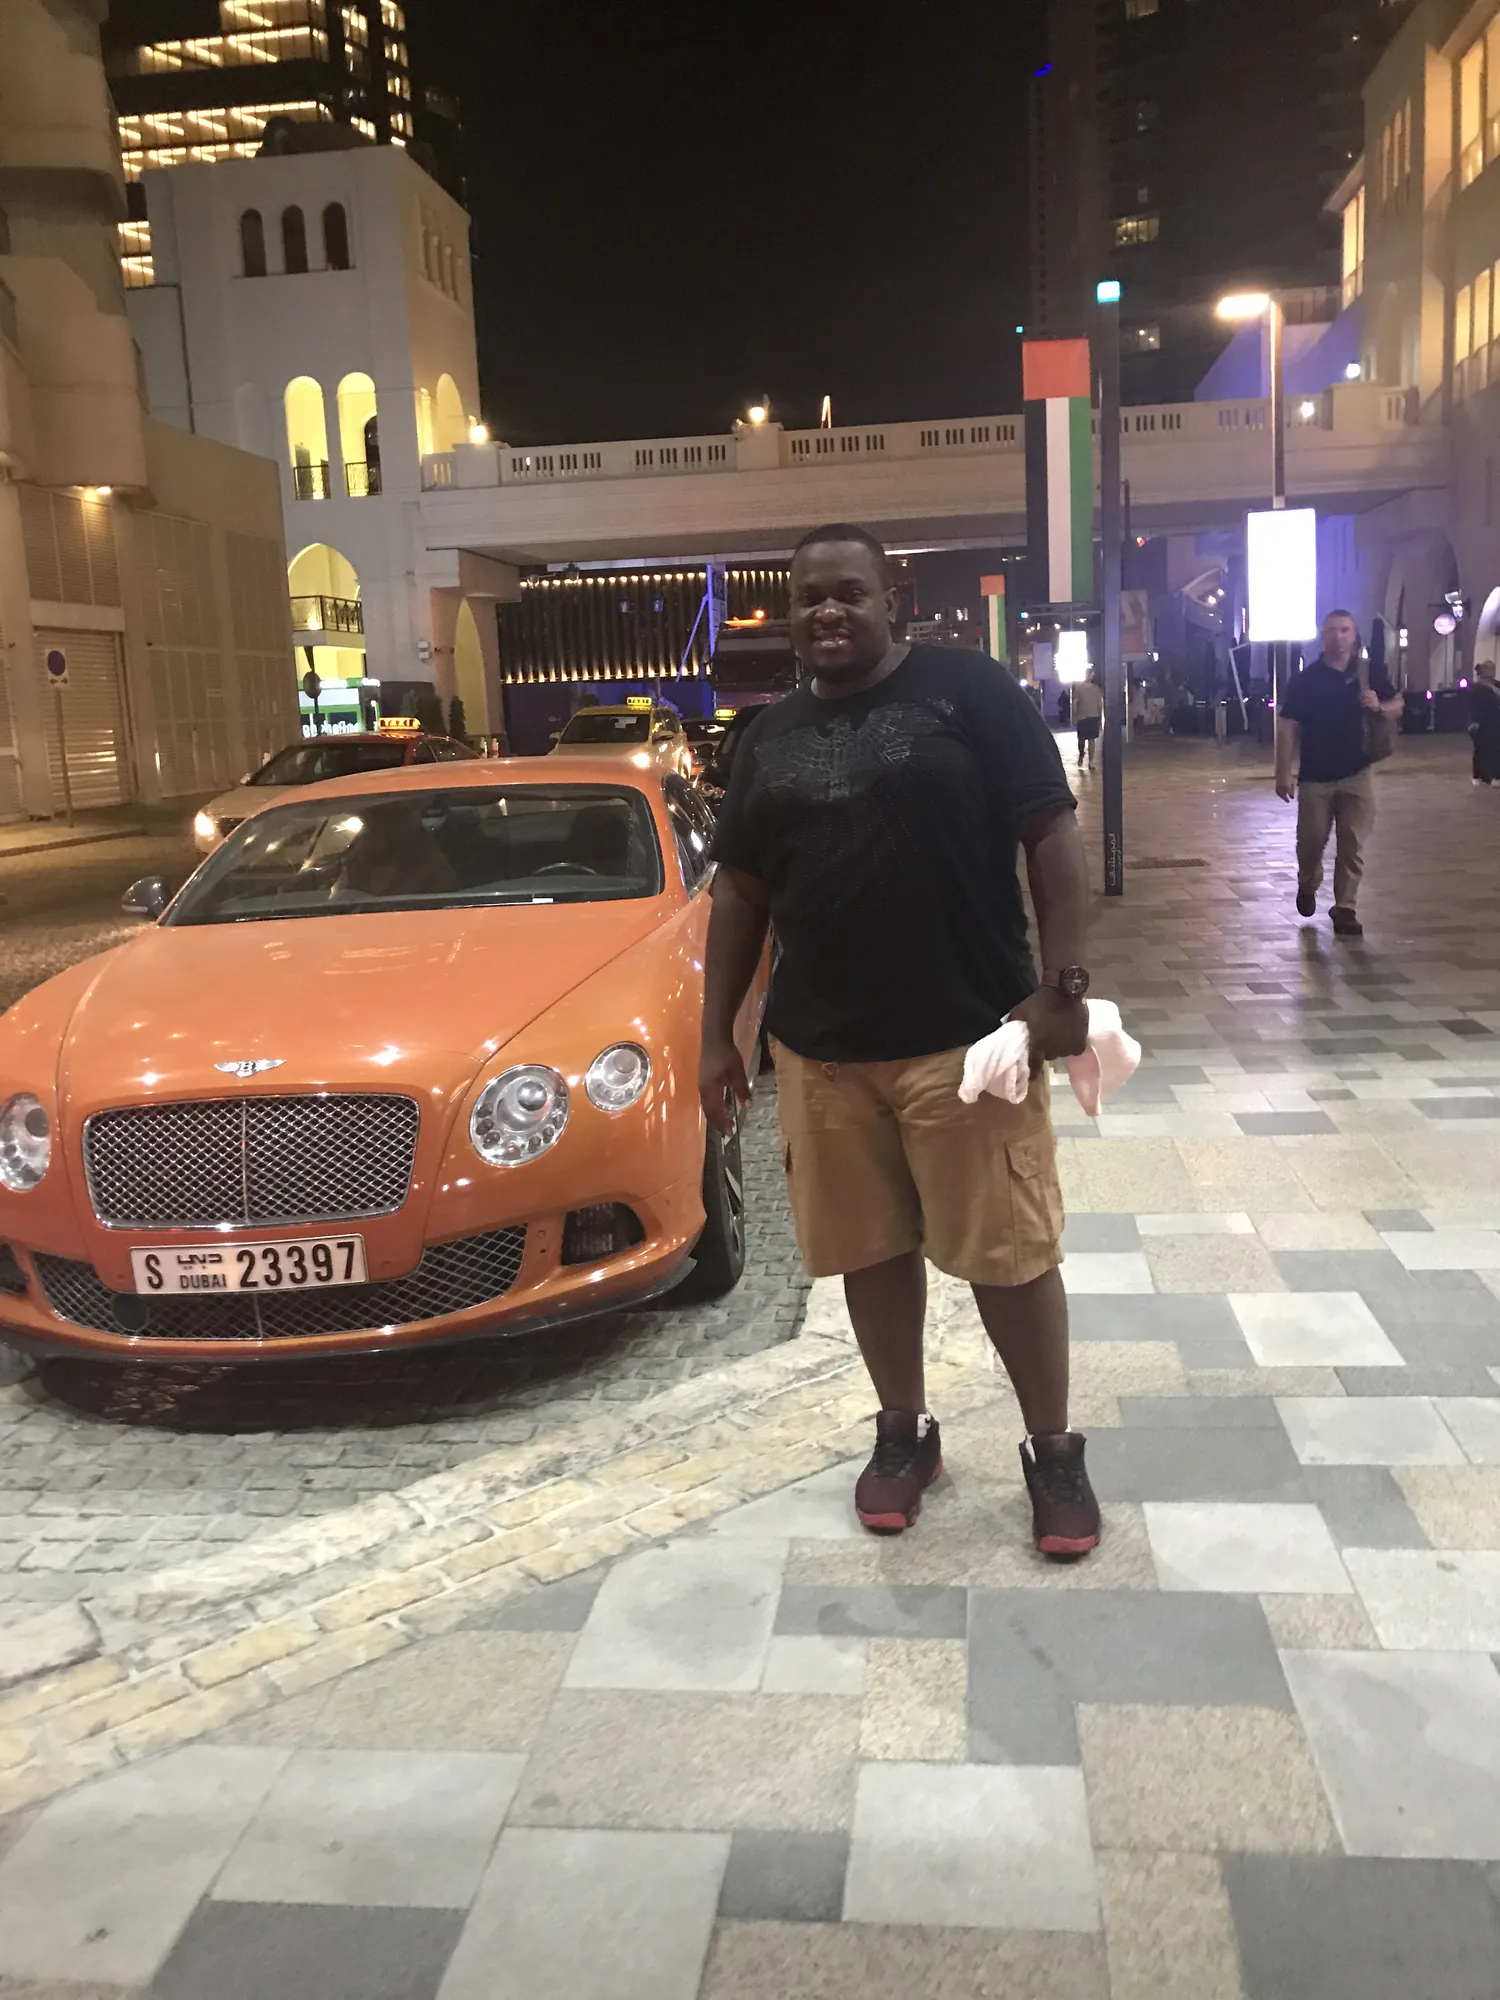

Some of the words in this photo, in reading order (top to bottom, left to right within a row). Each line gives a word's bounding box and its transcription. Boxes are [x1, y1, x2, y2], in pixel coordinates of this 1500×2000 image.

[380, 718, 414, 728] TAXI
[145, 1253, 164, 1289] S
[236, 1240, 356, 1288] 23397
[177, 1253, 223, 1270] دبي
[180, 1273, 227, 1289] DUBAI
